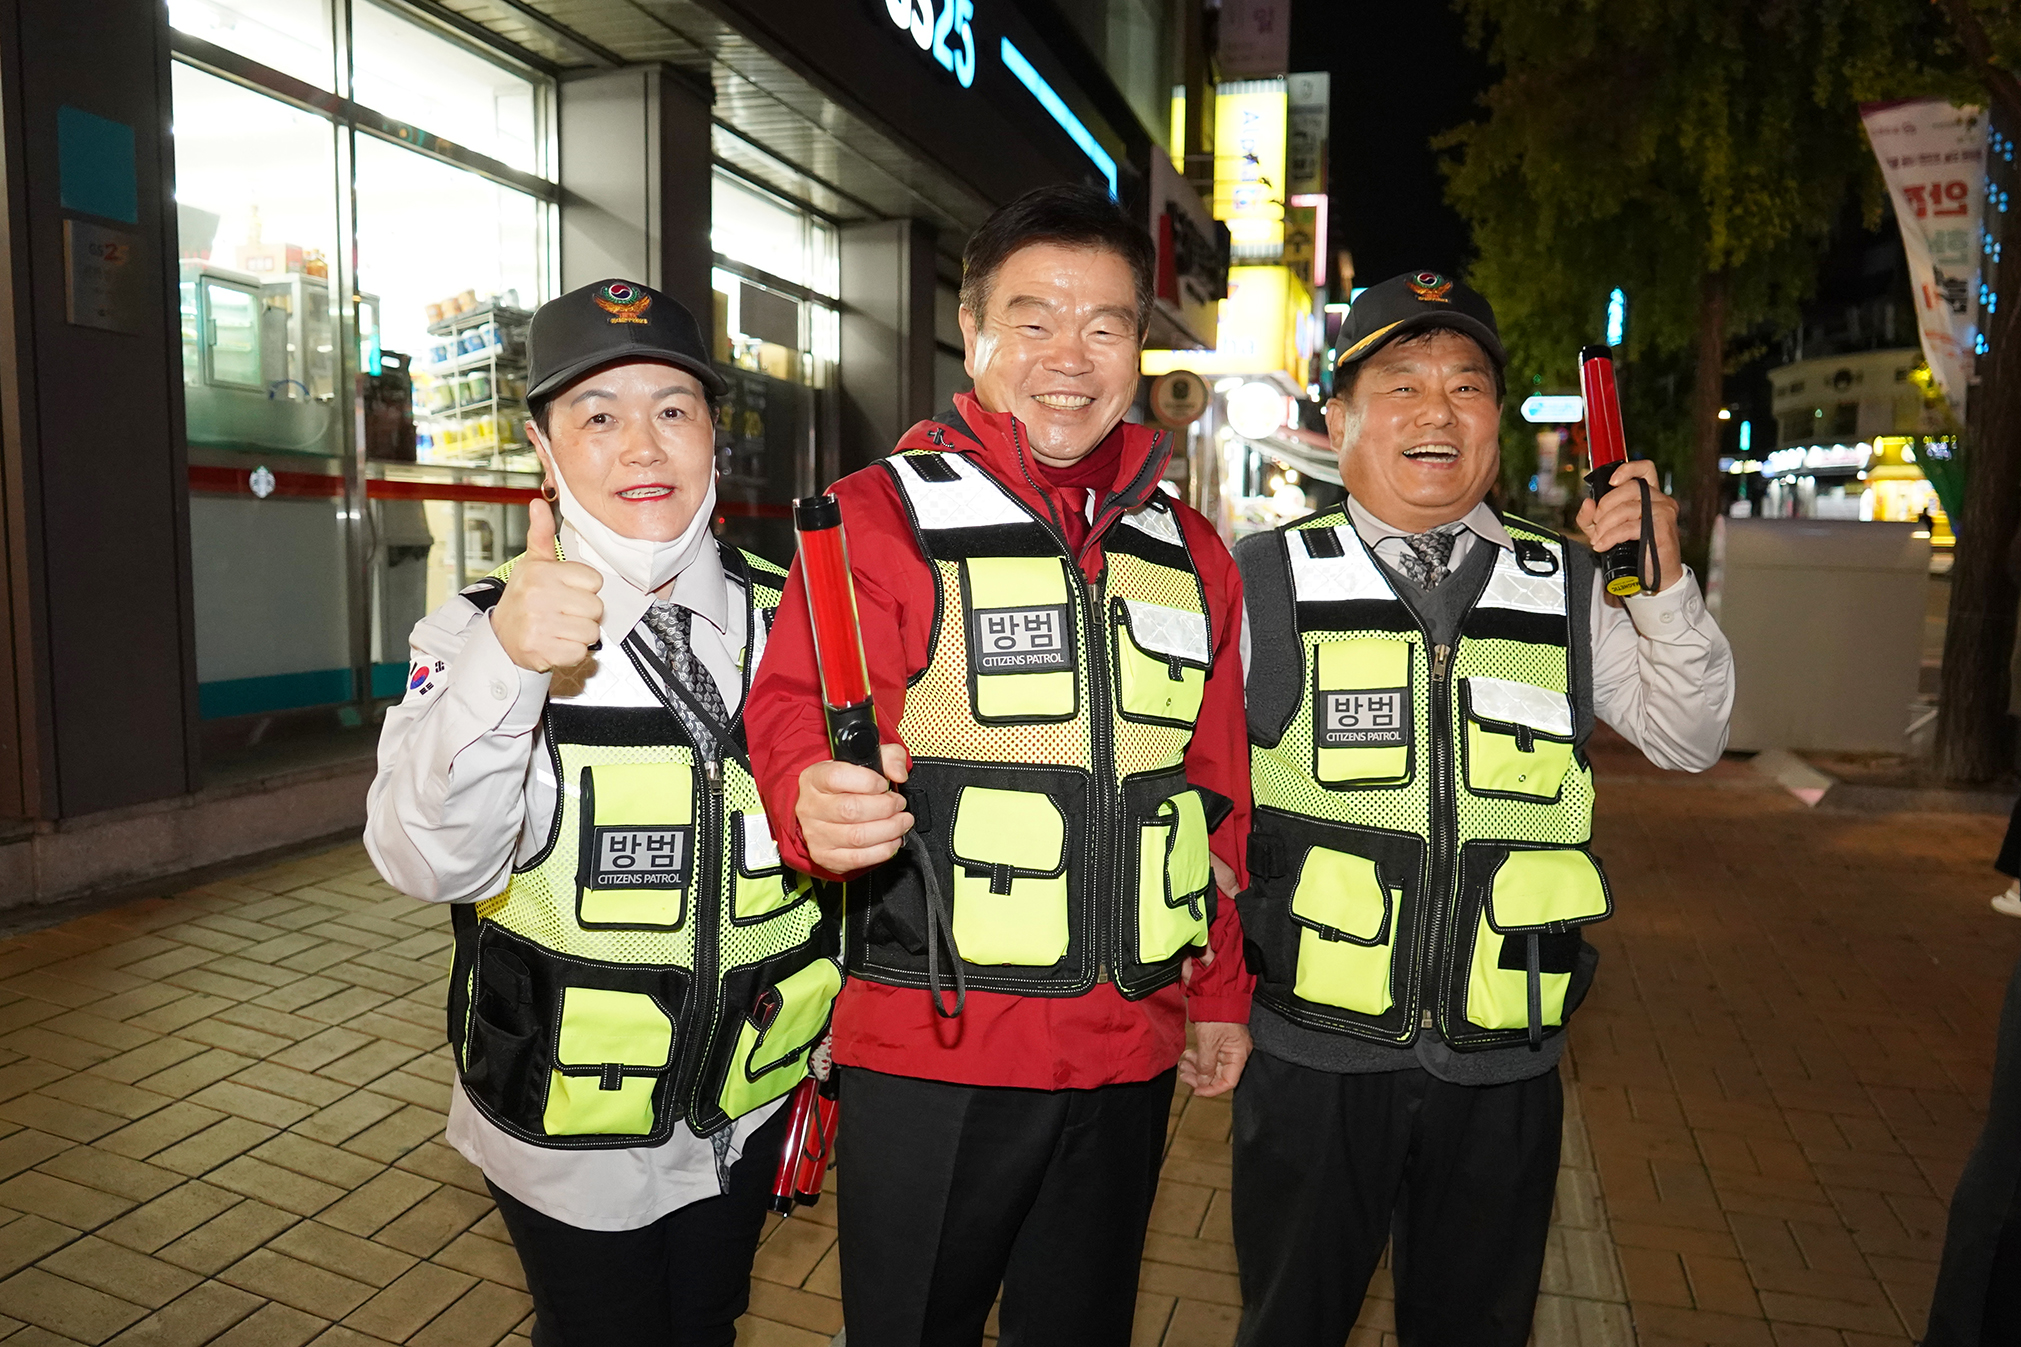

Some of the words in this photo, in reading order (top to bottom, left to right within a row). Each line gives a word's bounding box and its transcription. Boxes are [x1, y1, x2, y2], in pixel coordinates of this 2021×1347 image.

[988, 613, 1053, 650] 방범
[983, 655, 1025, 666] CITIZENS
[1027, 653, 1064, 664] PATROL
[1335, 695, 1393, 727] 방범
[1326, 732, 1366, 741] CITIZENS
[1367, 731, 1402, 741] PATROL
[609, 834, 676, 868] 방범
[598, 874, 642, 884] CITIZENS
[644, 873, 682, 883] PATROL
